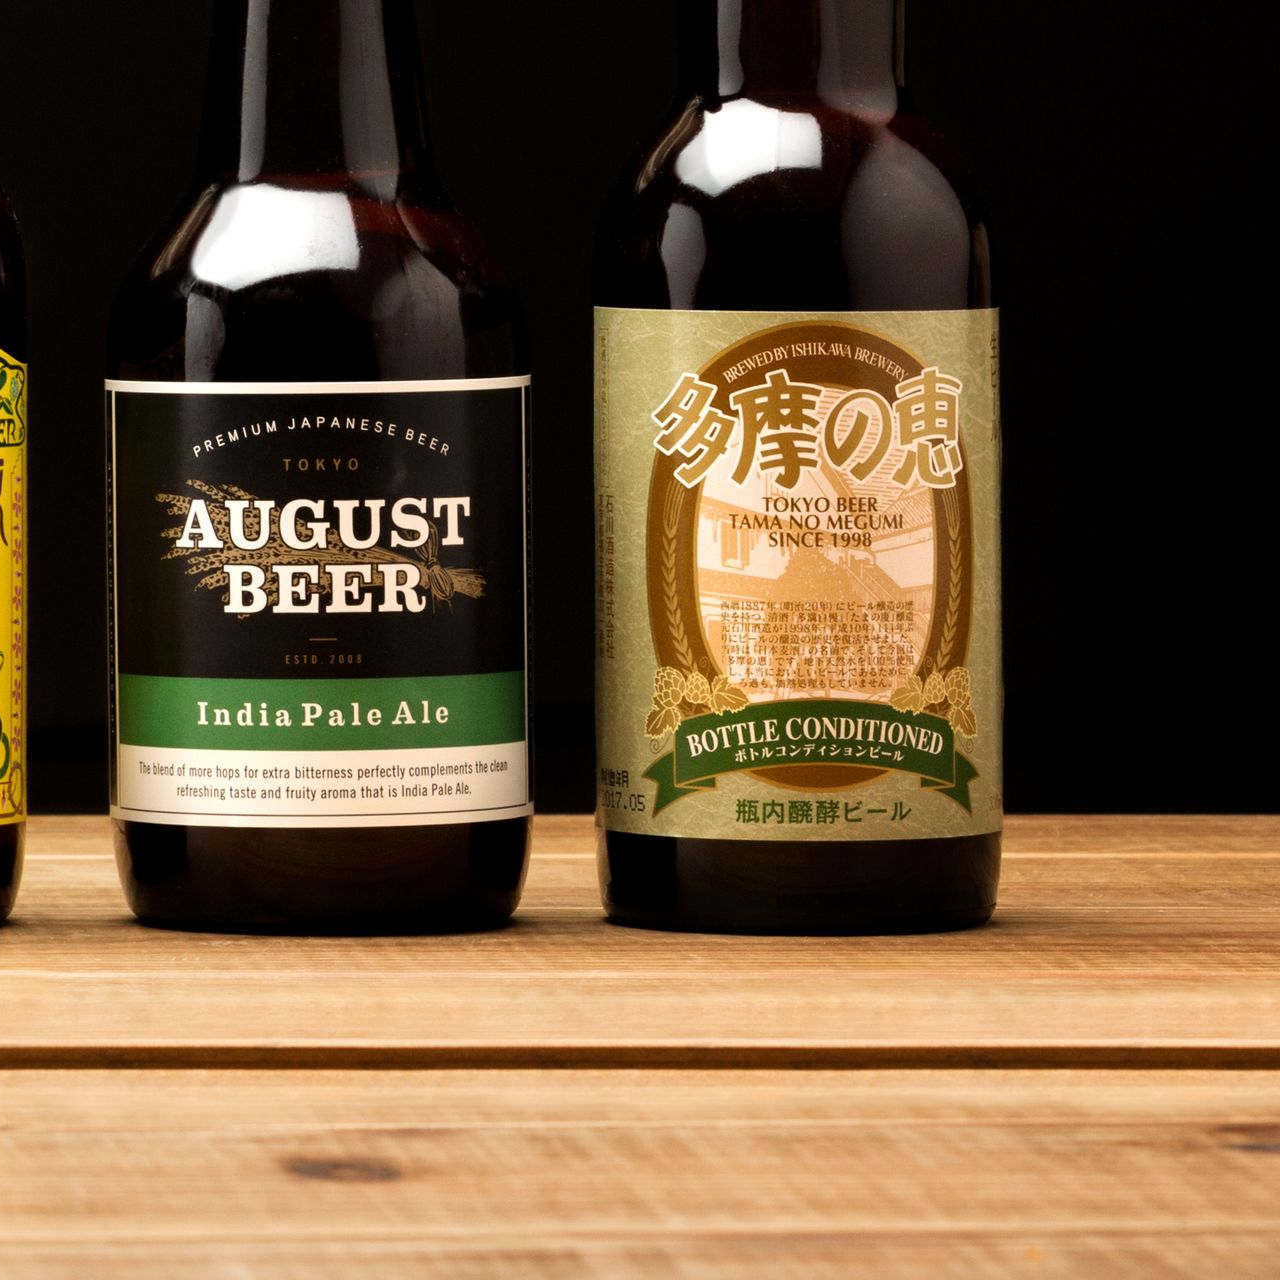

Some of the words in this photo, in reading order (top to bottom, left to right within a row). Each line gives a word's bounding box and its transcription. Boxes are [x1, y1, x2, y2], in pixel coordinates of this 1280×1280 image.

[722, 350, 774, 384] BREWED
[773, 344, 790, 362] BY
[791, 342, 852, 358] ISHIKAWA
[854, 347, 909, 382] BREWERY
[193, 420, 277, 458] PREMIUM
[287, 416, 397, 436] JAPANESE
[404, 428, 450, 456] BEER
[651, 366, 963, 490] 多摩の恵
[282, 458, 359, 471] TOKYO
[761, 496, 830, 513] TOKYO
[836, 496, 878, 513] BEER
[175, 495, 471, 552] AUGUST
[729, 513, 783, 530] TAMA
[789, 514, 820, 530] NO
[826, 514, 904, 530] MEGUMI
[768, 531, 823, 548] SINCE
[830, 532, 872, 548] 1998
[223, 563, 427, 614] BEER
[197, 701, 292, 727] India
[301, 702, 382, 727] Pale
[391, 700, 449, 725] Ale
[686, 719, 780, 758] BOTTLE
[785, 716, 944, 756] CONDITIONED
[734, 743, 905, 763] ボトルコンディションビール
[139, 761, 151, 775] The
[153, 762, 174, 777] blend
[176, 763, 186, 777] of
[189, 766, 213, 778] more
[215, 765, 240, 780] hops
[244, 765, 258, 779] for
[262, 766, 290, 779] extra
[294, 766, 353, 779] bitterness
[357, 764, 406, 781] perfectly
[408, 762, 473, 781] complements
[474, 761, 488, 774] the
[490, 759, 508, 773] clean
[176, 784, 226, 801] refreshing
[229, 786, 257, 799] taste
[260, 786, 282, 799] and
[285, 786, 317, 802] fruity
[320, 788, 356, 799] aroma
[360, 786, 384, 799] that
[388, 785, 398, 798] is
[401, 783, 428, 797] India
[431, 782, 453, 796] Pale
[455, 782, 472, 795] Ale.
